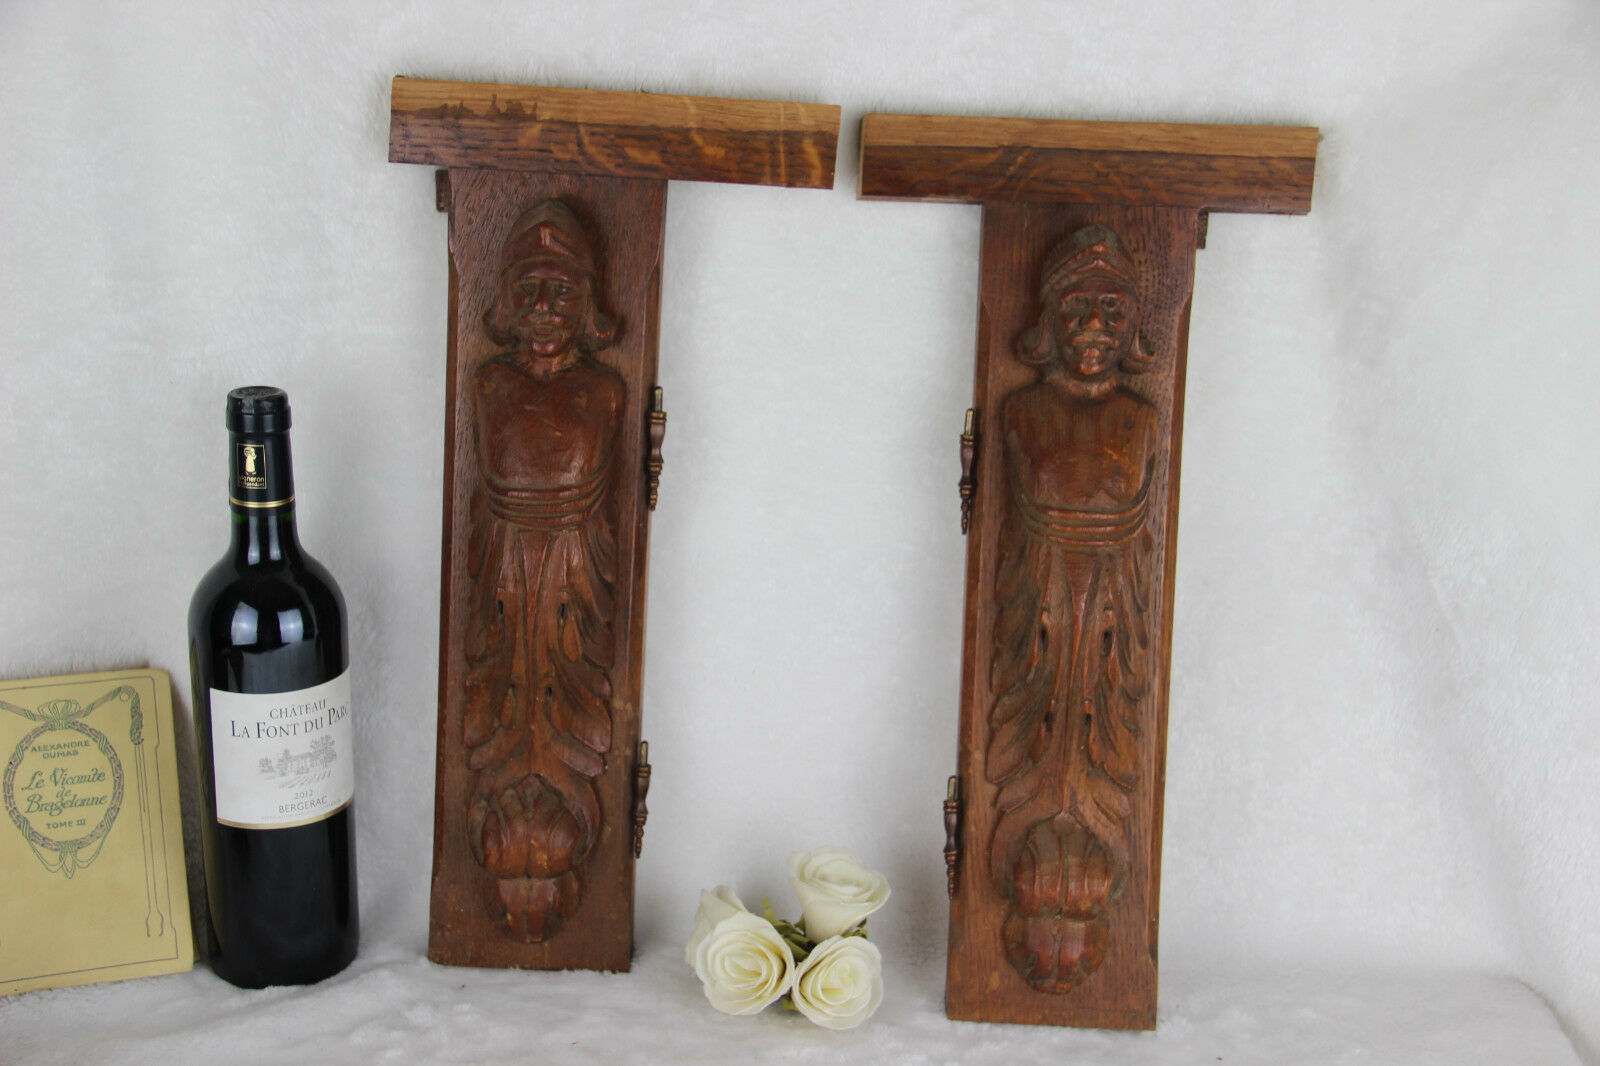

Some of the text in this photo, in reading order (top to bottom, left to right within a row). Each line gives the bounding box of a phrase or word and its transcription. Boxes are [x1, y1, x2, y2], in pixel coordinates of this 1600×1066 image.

[269, 699, 326, 720] CHÂTEAU
[256, 721, 299, 738] FONT
[304, 716, 323, 734] DU
[30, 740, 91, 753] ALEXANDRE
[42, 749, 79, 760] DUMAS
[21, 767, 106, 791] Le Vicomte
[56, 786, 72, 799] de
[295, 789, 313, 800] 2012
[278, 795, 327, 814] BERGERAC
[46, 820, 73, 830] TOME
